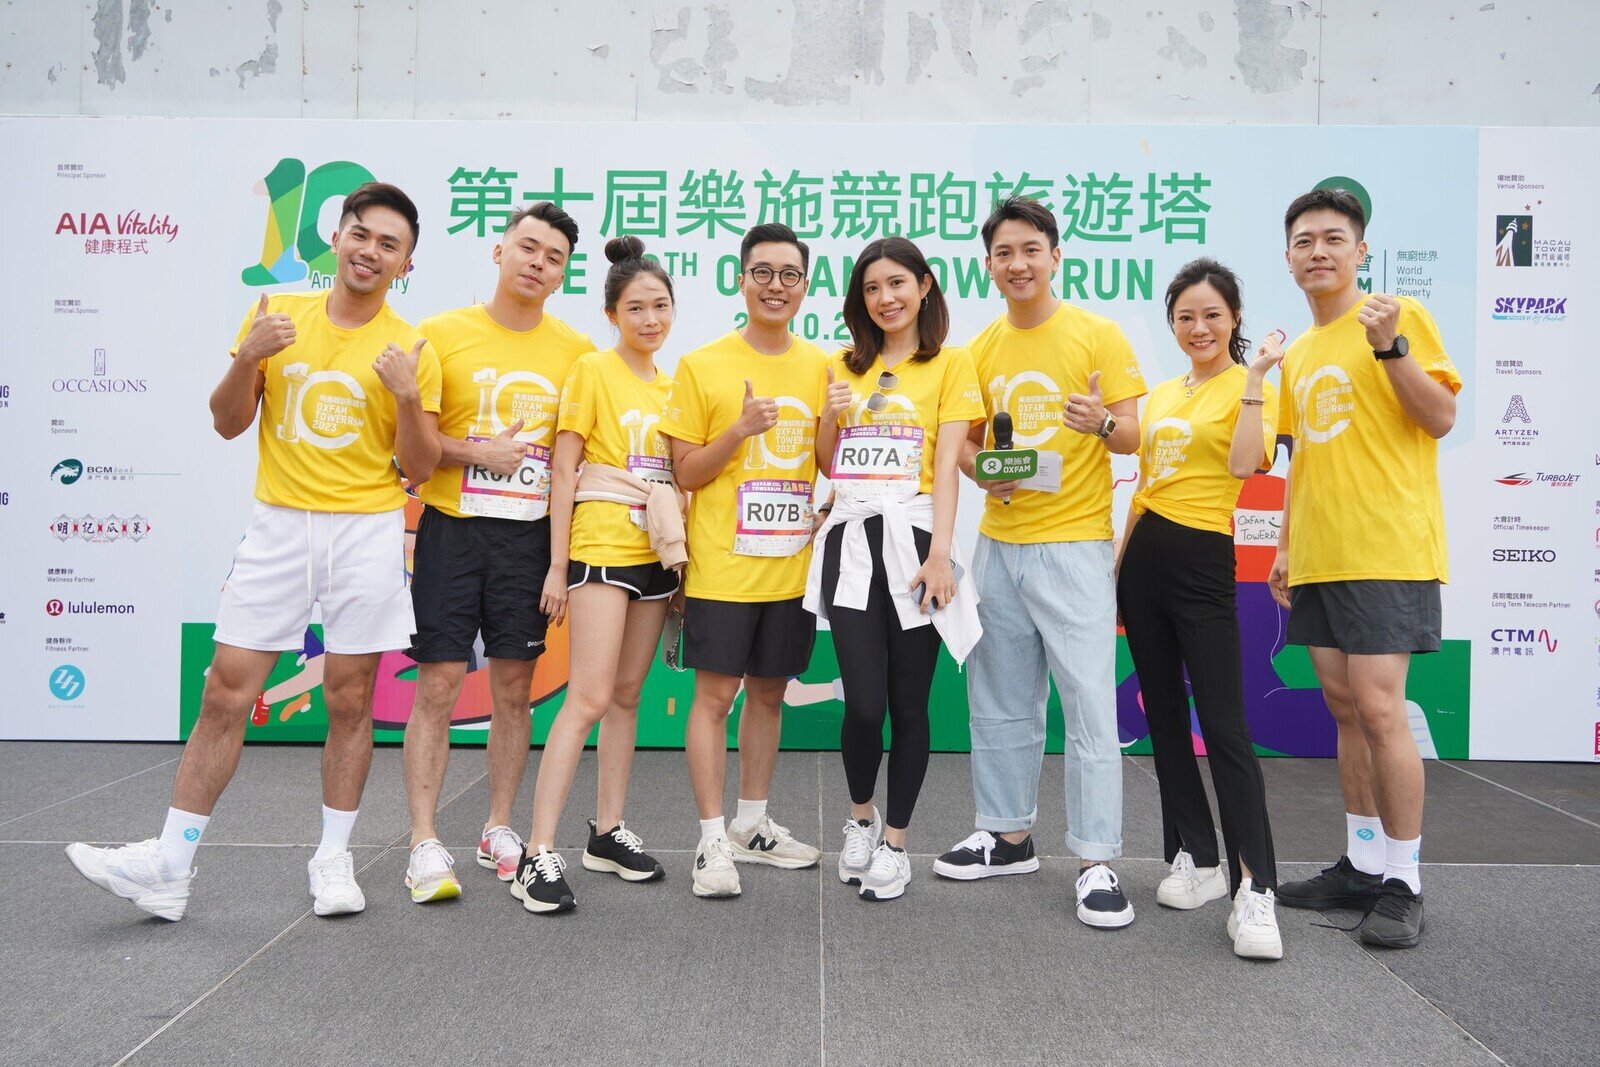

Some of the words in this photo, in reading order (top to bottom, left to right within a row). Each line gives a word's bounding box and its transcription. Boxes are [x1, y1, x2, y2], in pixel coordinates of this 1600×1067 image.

[55, 212, 110, 234] AIA
[118, 209, 179, 243] Vitality
[84, 239, 148, 254] 健康程式
[1397, 251, 1438, 261] 無窮世界
[1397, 266, 1422, 274] World
[1397, 277, 1432, 285] Without
[1397, 288, 1431, 299] Poverty
[1494, 297, 1567, 314] SKYPARK
[52, 379, 147, 392] OCCASIONS
[316, 403, 348, 414] OXFAM
[512, 401, 543, 410] OXFAM
[1019, 404, 1044, 413] OXFAM
[1019, 411, 1062, 421] TOWERRUN
[313, 420, 337, 432] 2023
[1019, 421, 1038, 430] 2023
[776, 428, 803, 436] OXFAM
[841, 447, 900, 466] R07A
[1003, 465, 1031, 473] OXFAM
[747, 502, 800, 522] R07B
[1492, 549, 1556, 562] SEIKO
[68, 602, 134, 614] lululemon
[1491, 629, 1534, 642] CTM
